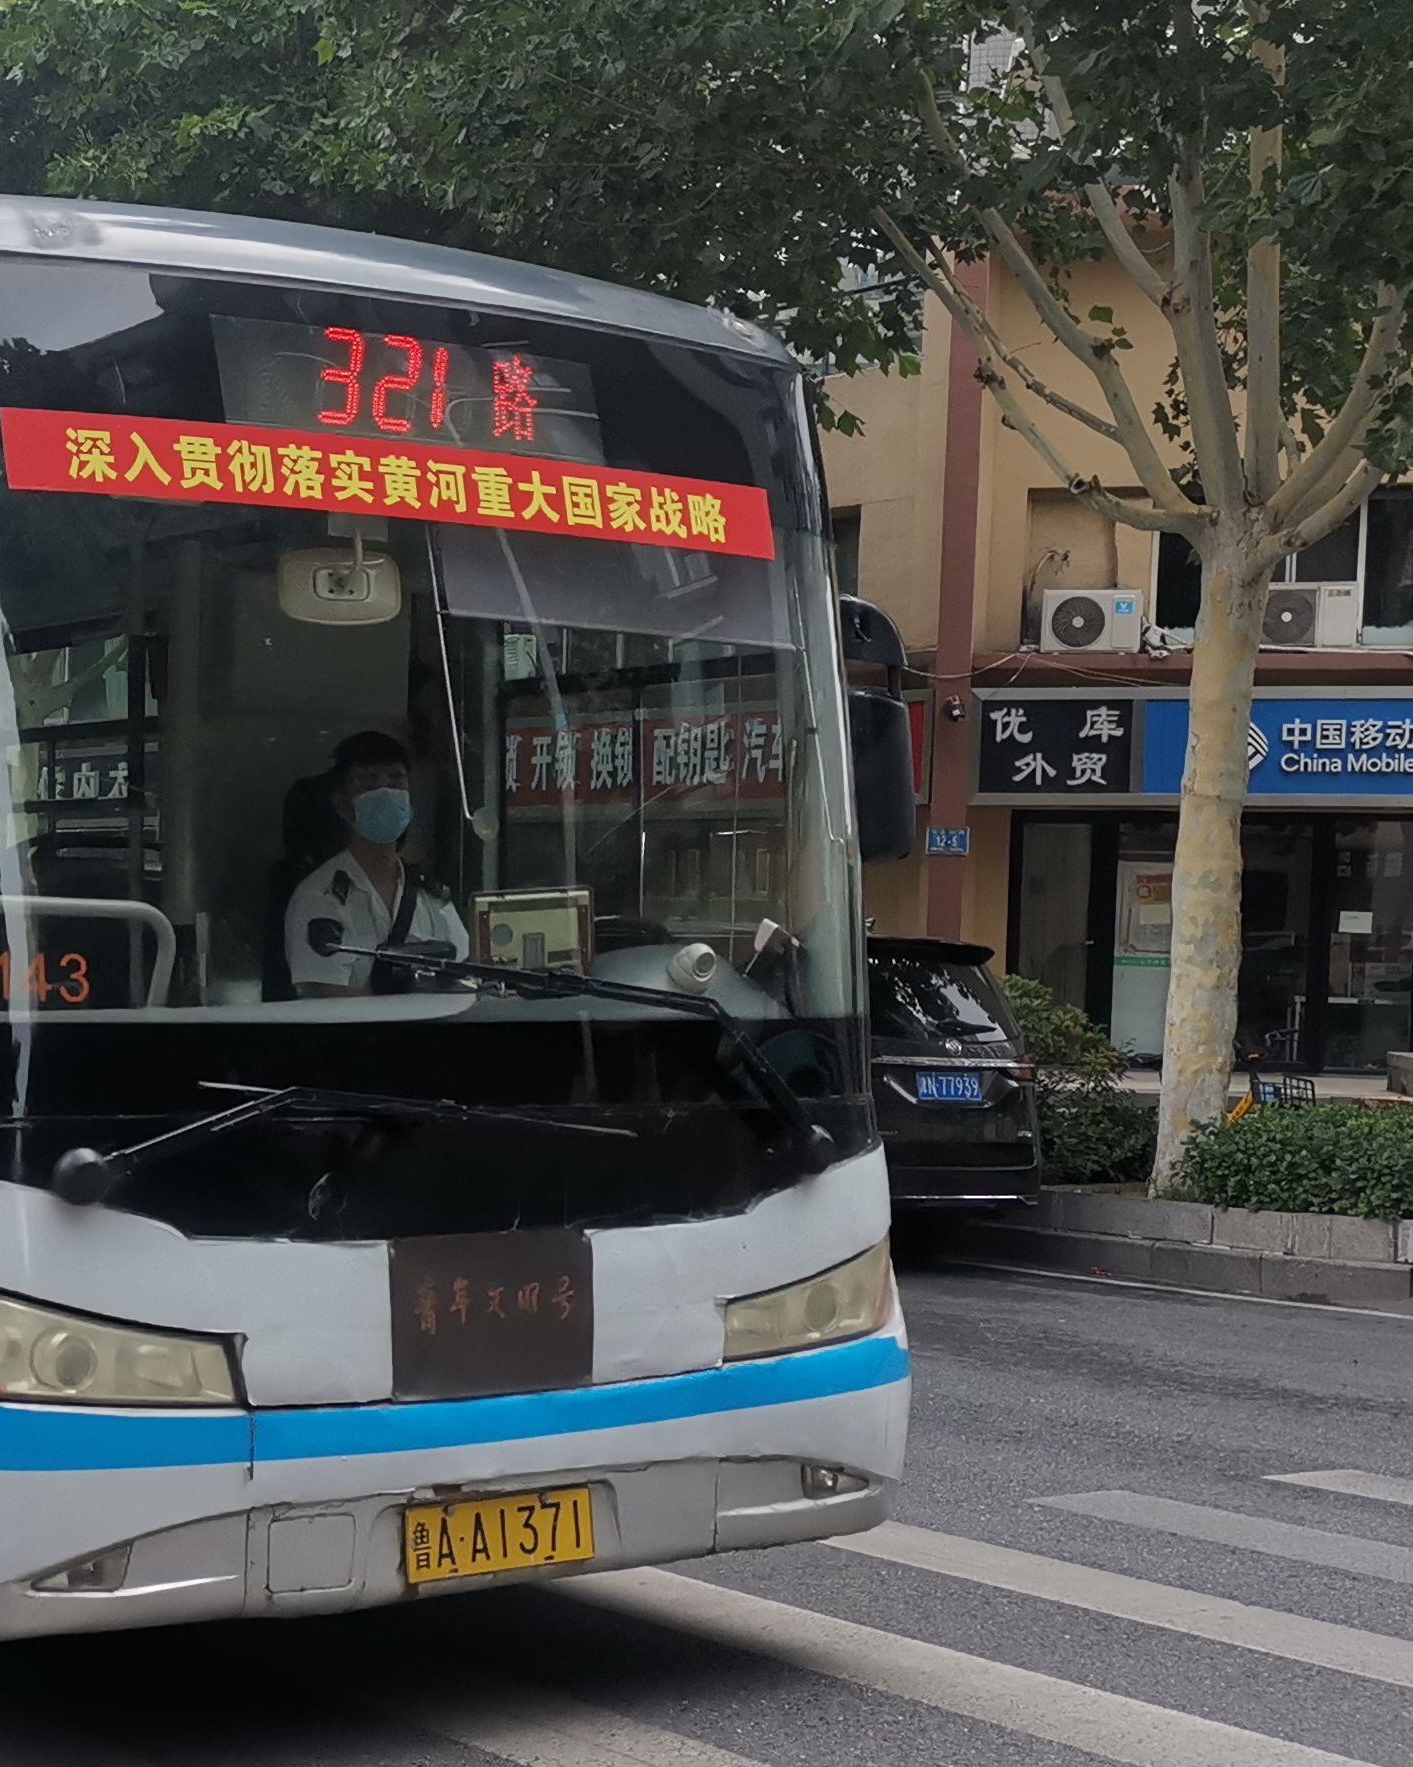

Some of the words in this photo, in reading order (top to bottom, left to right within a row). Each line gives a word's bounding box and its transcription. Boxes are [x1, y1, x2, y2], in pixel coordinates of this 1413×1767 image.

[317, 325, 450, 433] 321
[491, 354, 538, 442] 路
[65, 426, 728, 544] 深入贯彻落实黄河重大国家战略
[1281, 717, 1413, 750] 中国移动
[1011, 752, 1108, 786] 外贸
[1280, 752, 1343, 774] China
[1347, 753, 1413, 773] Mobile
